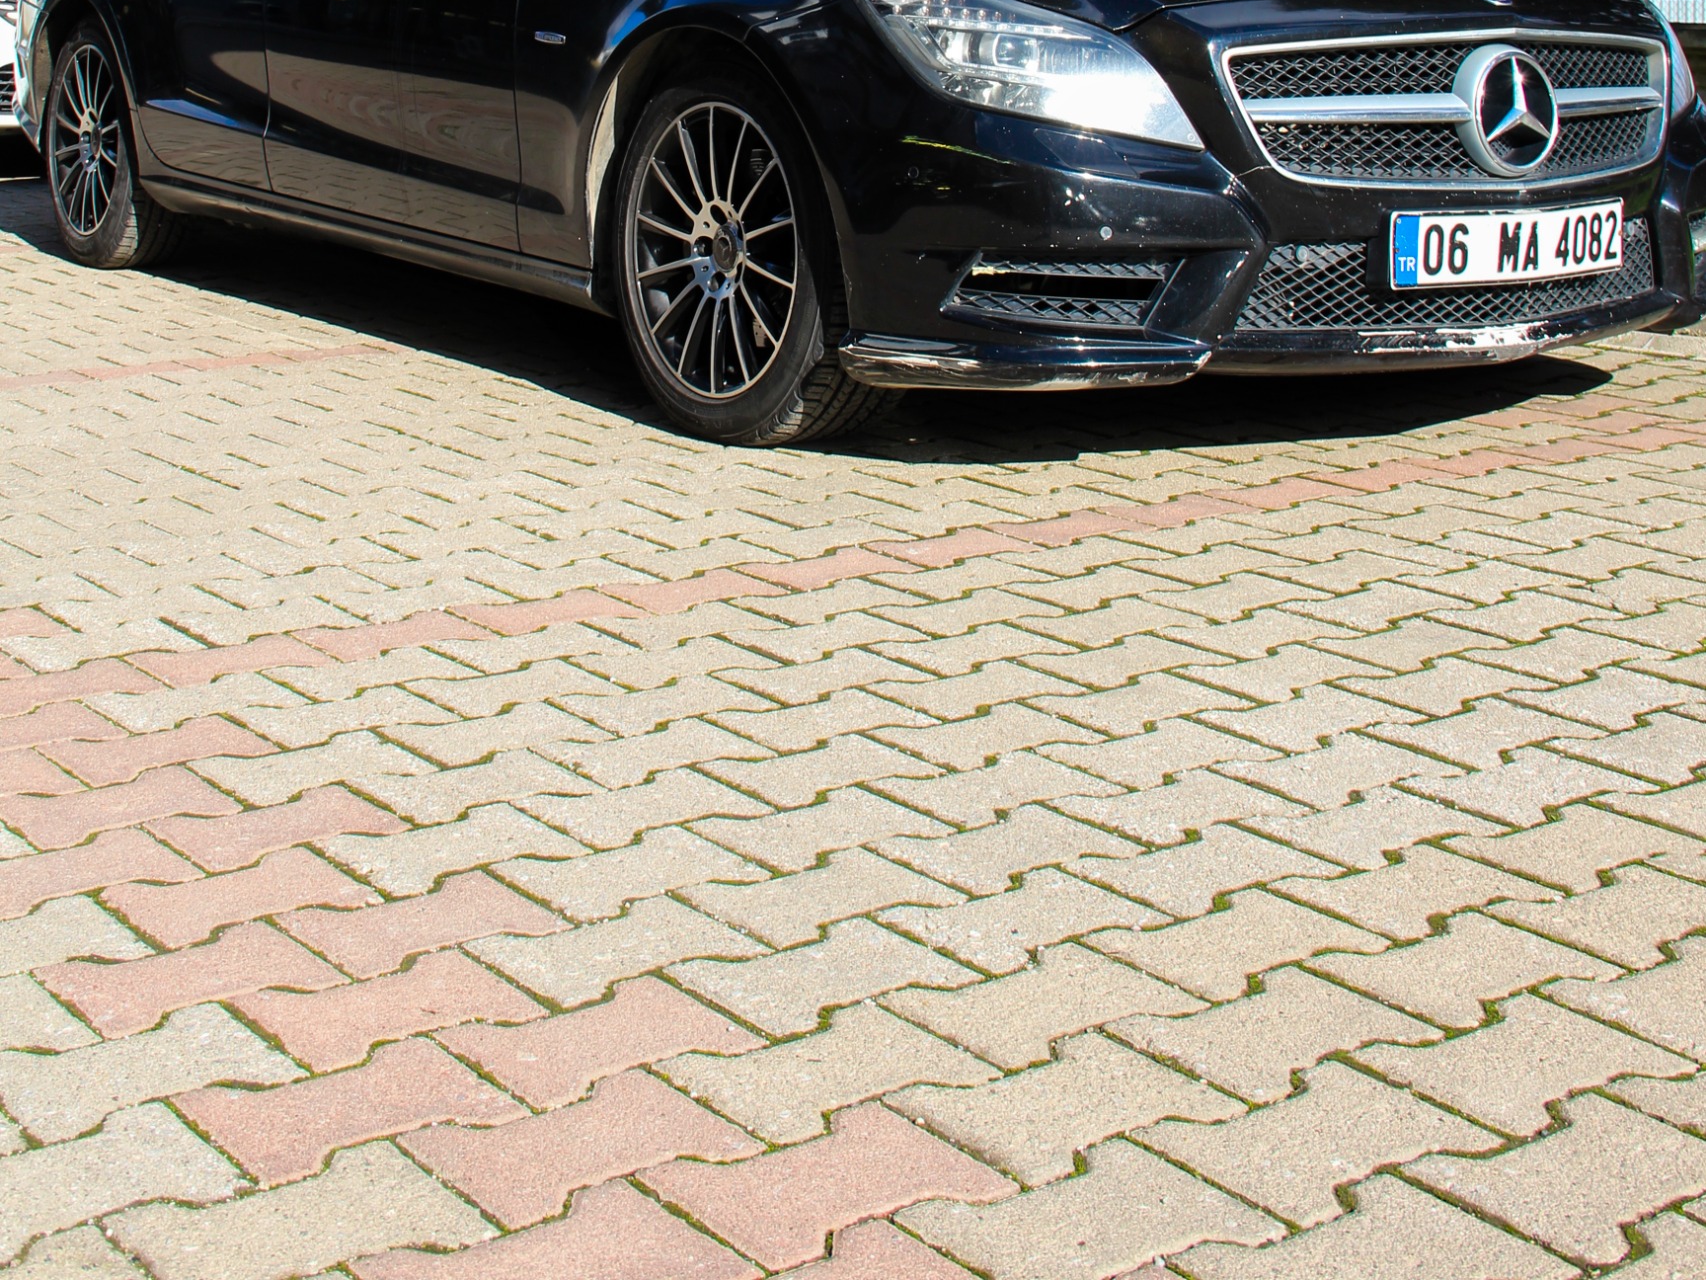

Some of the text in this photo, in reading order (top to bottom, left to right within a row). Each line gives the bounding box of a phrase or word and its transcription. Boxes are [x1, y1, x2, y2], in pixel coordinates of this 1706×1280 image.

[1423, 210, 1618, 276] 06 MA 4082
[1398, 256, 1416, 271] TR
